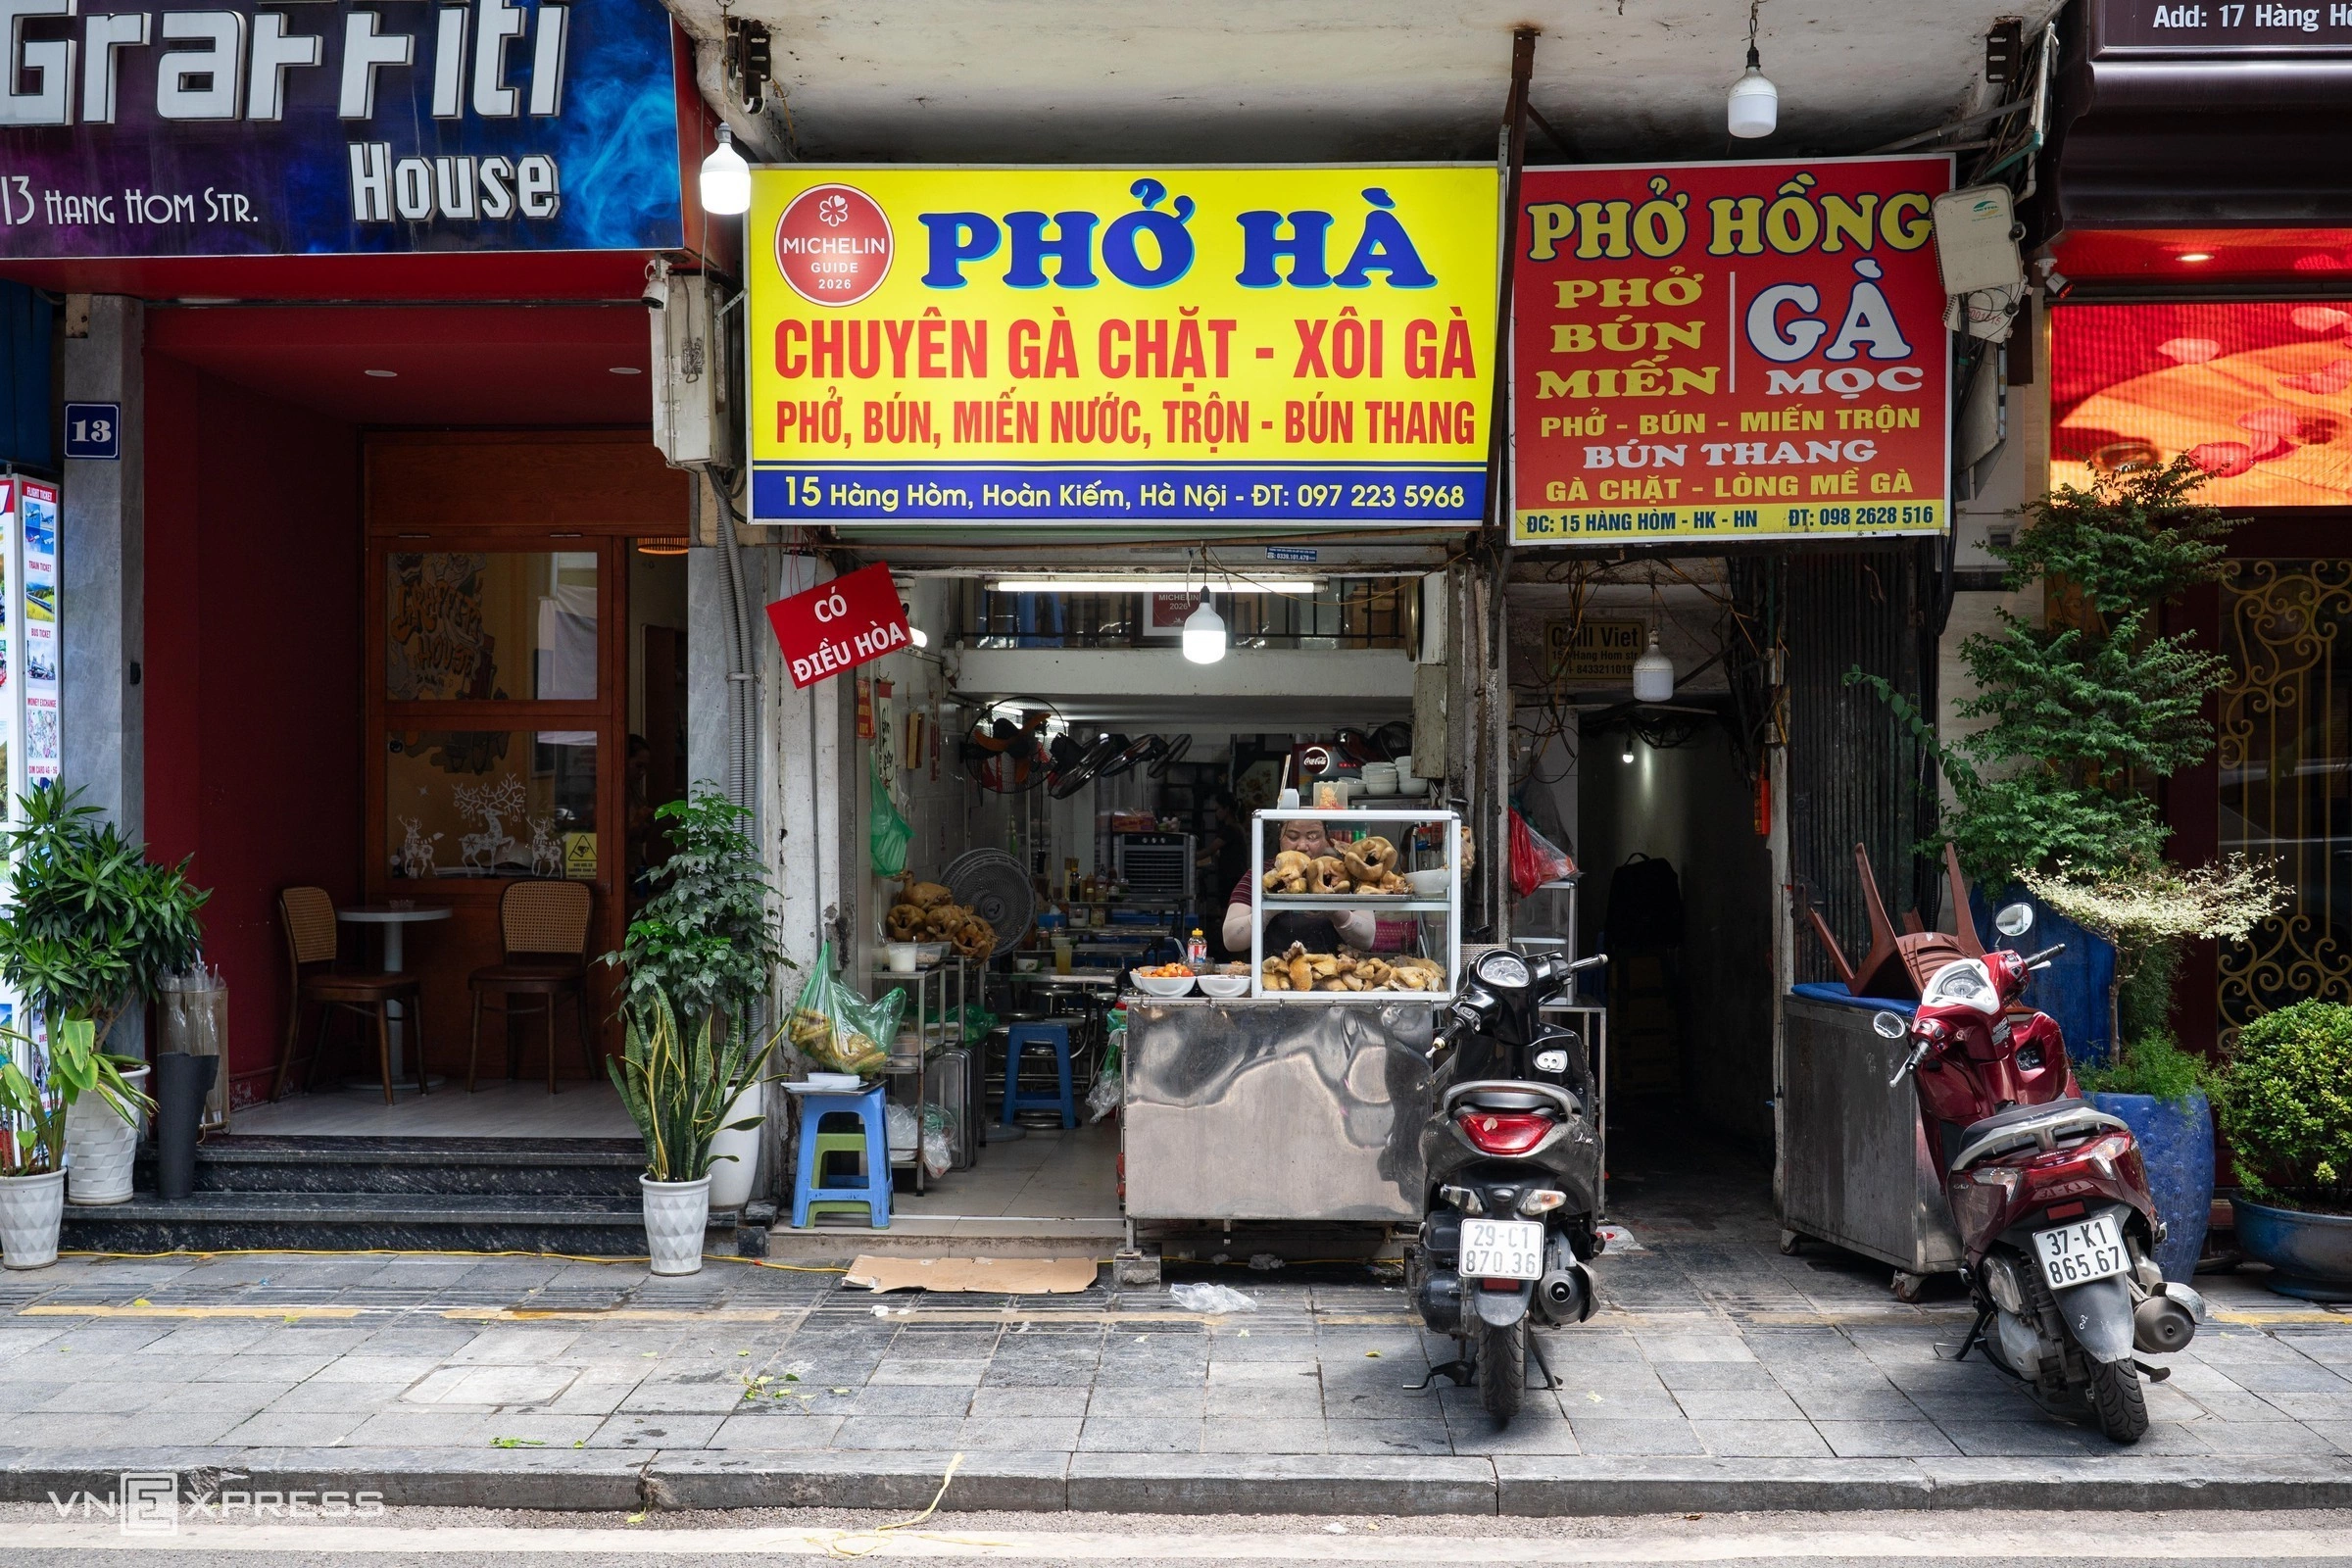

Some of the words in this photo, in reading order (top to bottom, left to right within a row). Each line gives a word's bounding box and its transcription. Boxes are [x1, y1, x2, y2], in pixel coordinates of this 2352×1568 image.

[2153, 5, 2207, 28] Add:
[2219, 5, 2245, 27] 17
[2255, 3, 2320, 32] Hàng
[347, 141, 561, 222] House
[1, 175, 35, 225] 13
[1525, 174, 1690, 261] PHỞ
[1707, 172, 1933, 257] HỒNG
[783, 237, 885, 255] MICHELIN
[918, 177, 1195, 290] PHỞ
[1235, 186, 1439, 290] HÀ
[810, 262, 858, 273] GUIDE
[817, 278, 852, 290] 2026
[1552, 266, 1704, 309] PHỞ
[1745, 258, 1913, 363] GÀ
[774, 306, 988, 379] CHUYÊN
[1007, 306, 1080, 379] GÀ
[1098, 306, 1237, 392] CHẶT
[1255, 347, 1274, 359] -
[1293, 306, 1383, 379] XÔI
[1404, 306, 1477, 379] GÀ
[1549, 314, 1706, 354] BÚN
[1765, 367, 1924, 401] MỌC
[71, 418, 113, 443] 13
[776, 385, 852, 449] PHỞ,
[863, 391, 941, 449] BÚN,
[954, 386, 1039, 444] MIẾN
[1051, 391, 1152, 449] NƯỚC,
[1162, 391, 1250, 454] TRỘN
[1285, 391, 1353, 444] BÚN
[1365, 400, 1475, 445] THANG
[1541, 407, 1608, 438] PHỞ
[1639, 409, 1706, 436] BÚN
[1835, 405, 1921, 434] TRỘN
[1583, 438, 1688, 470] BÚN
[1700, 439, 1878, 467] THANG
[785, 476, 822, 508] 15
[830, 481, 899, 513] Hàng
[907, 481, 974, 510] Hòm,
[983, 481, 1052, 508] Hoàn
[1059, 478, 1131, 510] Kiếm,
[1140, 481, 1176, 508] Hà
[1184, 482, 1227, 512] Nội
[1251, 484, 1290, 508] ĐT:
[1298, 484, 1343, 508] 097
[1350, 484, 1396, 508] 223
[1403, 484, 1465, 509] 5968
[1545, 476, 1589, 503] GÀ
[1598, 474, 1682, 504] CHẶT
[1714, 471, 1799, 498] LÒNG
[1809, 466, 1862, 495] MỀ
[1871, 468, 1914, 494] GÀ
[1526, 514, 1555, 534] ĐC:
[1559, 514, 1581, 532] 15
[1585, 510, 1633, 533] HÀNG
[1637, 508, 1677, 531] HÒM
[1692, 511, 1717, 529] HK
[1733, 510, 1758, 528] HN
[1788, 509, 1815, 527] ĐT:
[1819, 508, 1850, 526] 098
[1855, 507, 1898, 525] 2628
[1902, 506, 1934, 524] 516
[814, 586, 848, 623] CÓ
[792, 638, 852, 682] ĐIỀU
[854, 620, 906, 658] HÒA
[1600, 627, 1639, 647] Viet
[2036, 1150, 2071, 1159] HONDA
[1473, 1224, 1529, 1250] 29-C1
[2046, 1221, 2107, 1256] 37-K1
[1465, 1250, 1536, 1275] 870.36
[2048, 1246, 2120, 1285] 865.67
